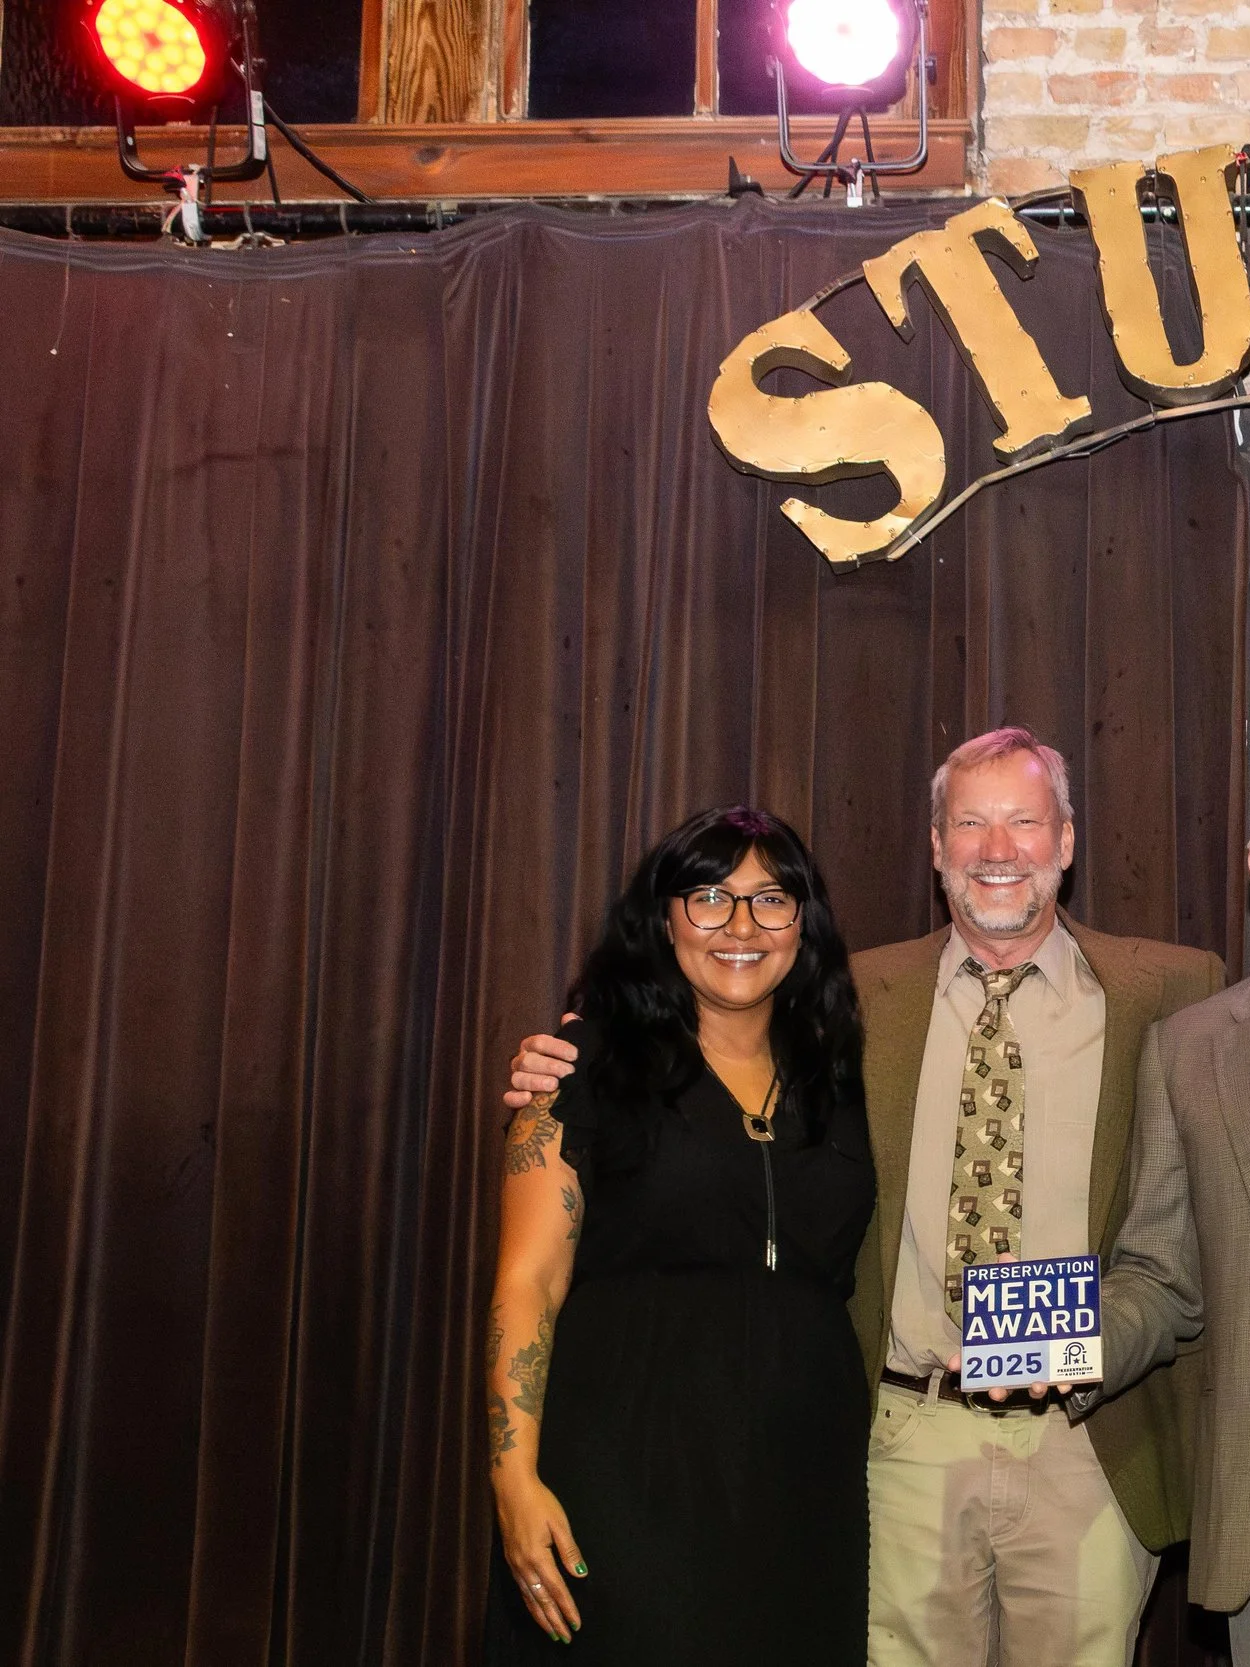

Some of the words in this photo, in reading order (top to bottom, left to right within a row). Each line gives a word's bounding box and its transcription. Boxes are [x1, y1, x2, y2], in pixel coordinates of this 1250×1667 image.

[967, 1260, 1094, 1282] PRESERVATION
[967, 1276, 1094, 1314] MERIT
[966, 1308, 1095, 1340] AWARD
[966, 1352, 1042, 1379] 2025
